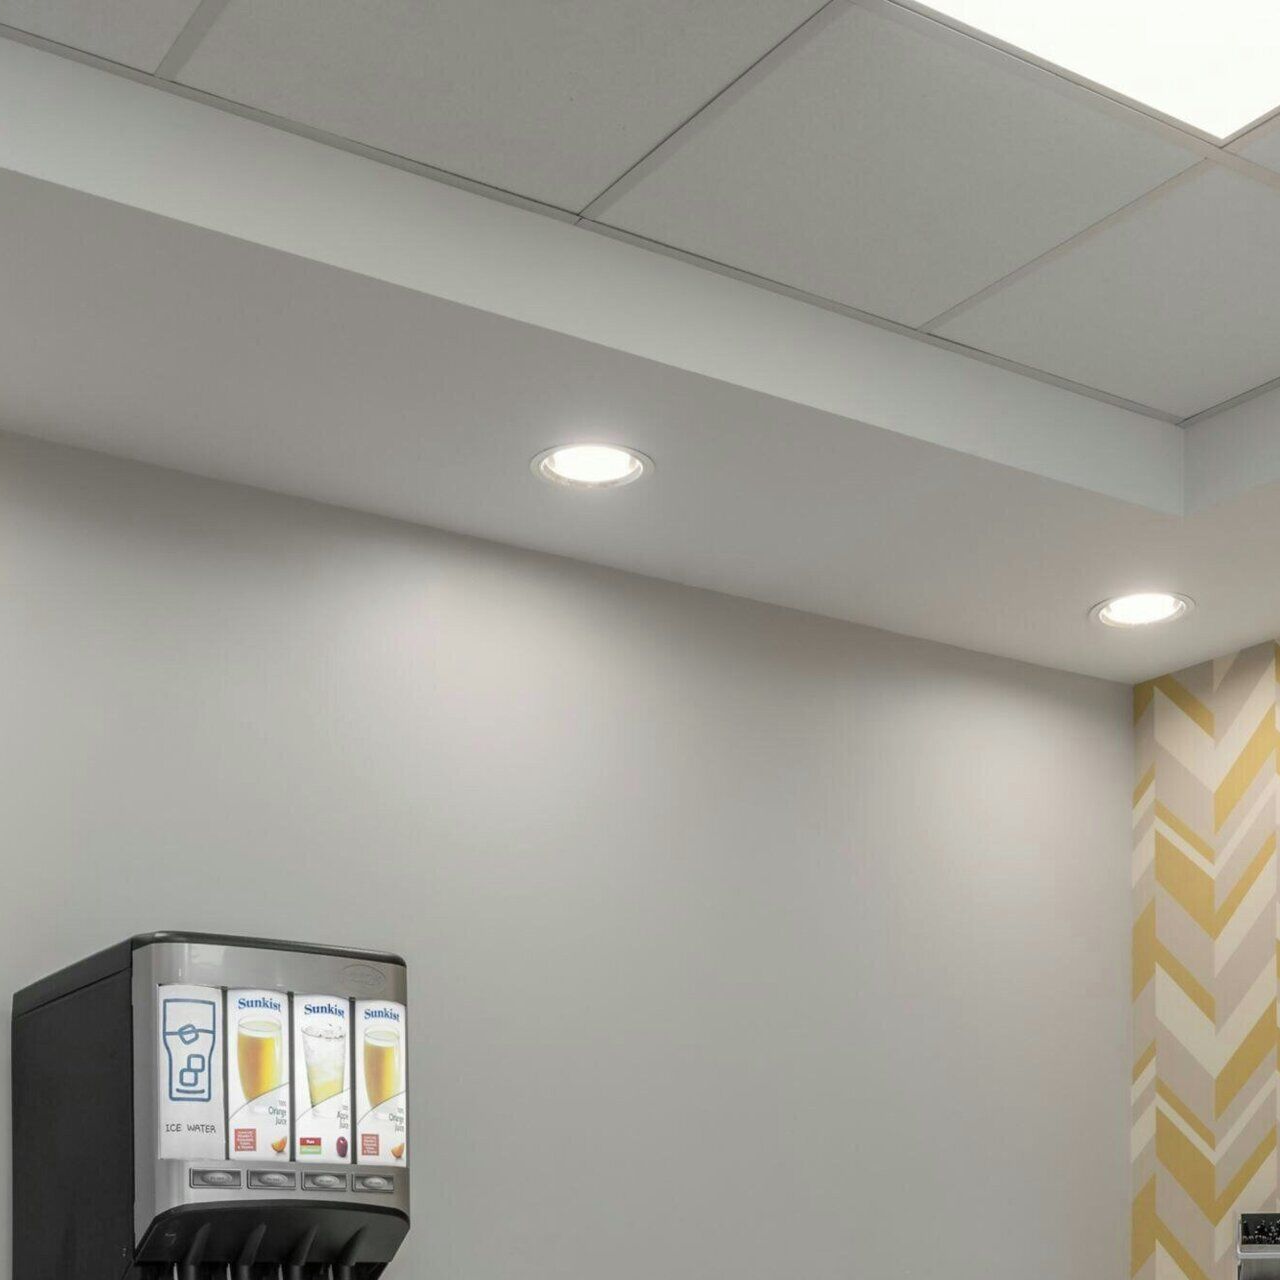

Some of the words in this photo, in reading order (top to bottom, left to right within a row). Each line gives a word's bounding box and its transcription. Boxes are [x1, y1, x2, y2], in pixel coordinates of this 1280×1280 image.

[238, 997, 281, 1012] Sunkist
[304, 1003, 345, 1019] Sunkist
[364, 1008, 400, 1022] Sunkist
[165, 1124, 182, 1132] ICE
[187, 1124, 216, 1134] WATER
